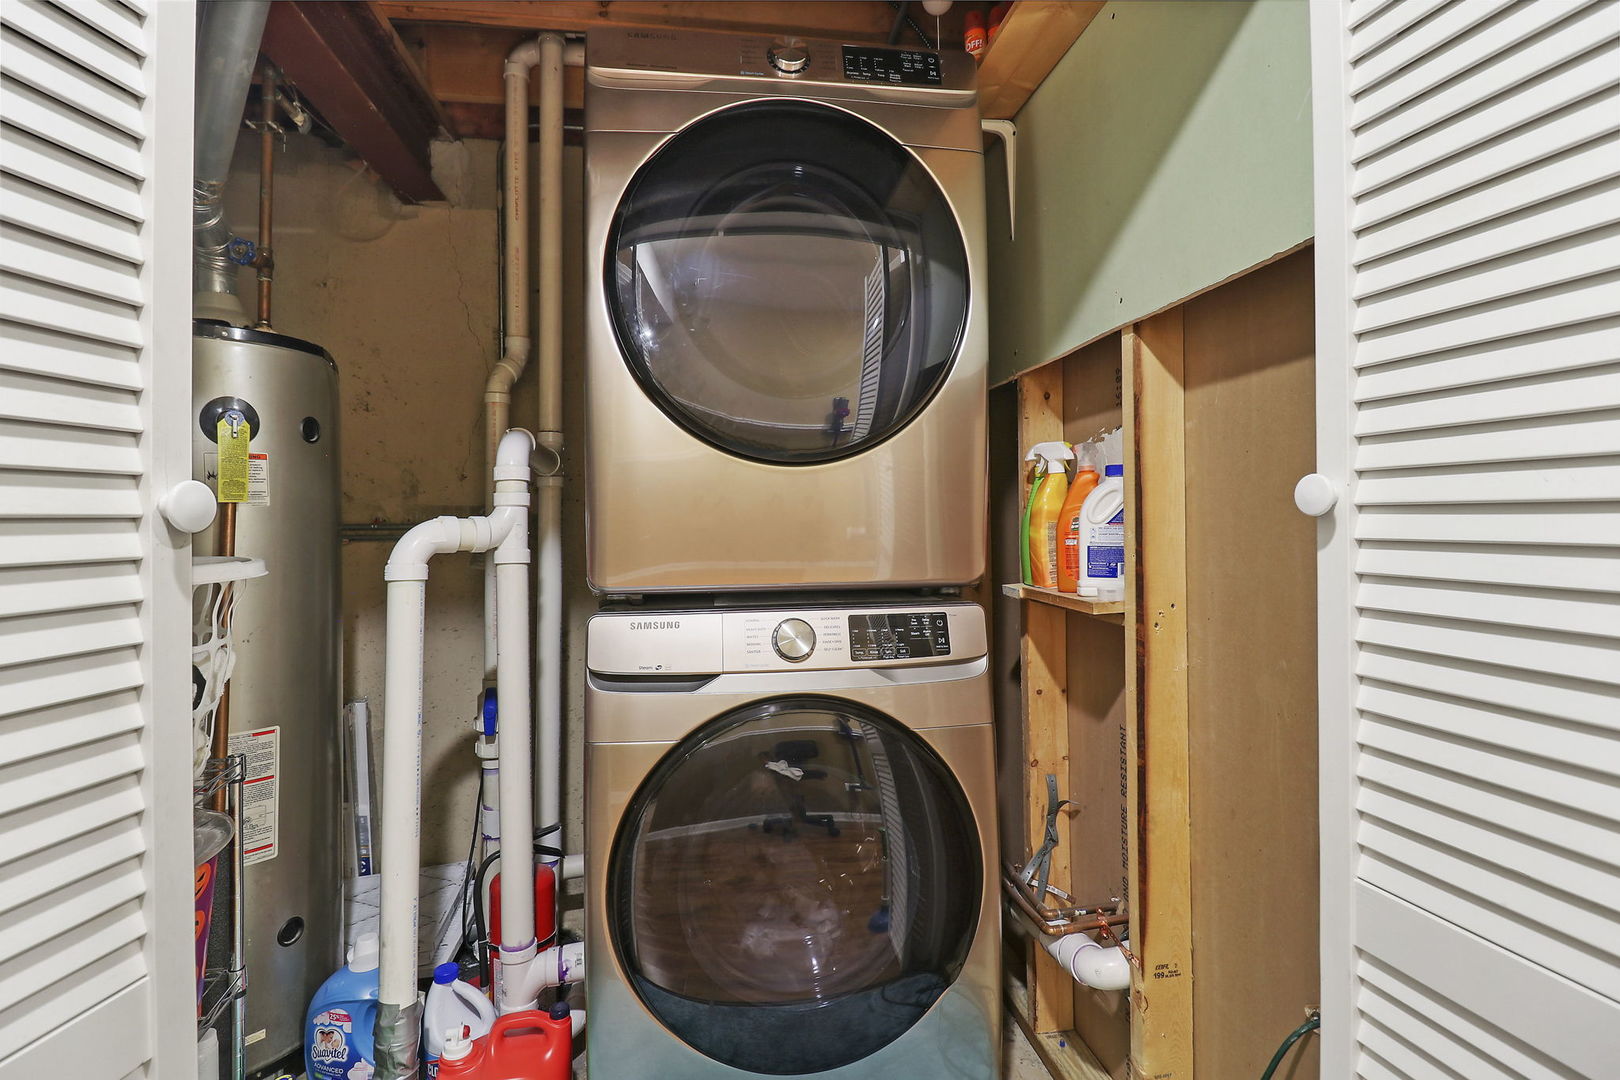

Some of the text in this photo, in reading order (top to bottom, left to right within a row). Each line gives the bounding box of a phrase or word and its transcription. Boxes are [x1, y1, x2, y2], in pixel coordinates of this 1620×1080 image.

[627, 32, 677, 40] SAMSUNG
[965, 39, 983, 52] OFF!
[630, 621, 680, 630] SAMSUNG
[1119, 723, 1128, 799] RESISTANT
[1120, 803, 1128, 872] MOISTURE
[312, 1046, 346, 1060] Suavitel
[314, 1063, 344, 1074] ADVANCED
